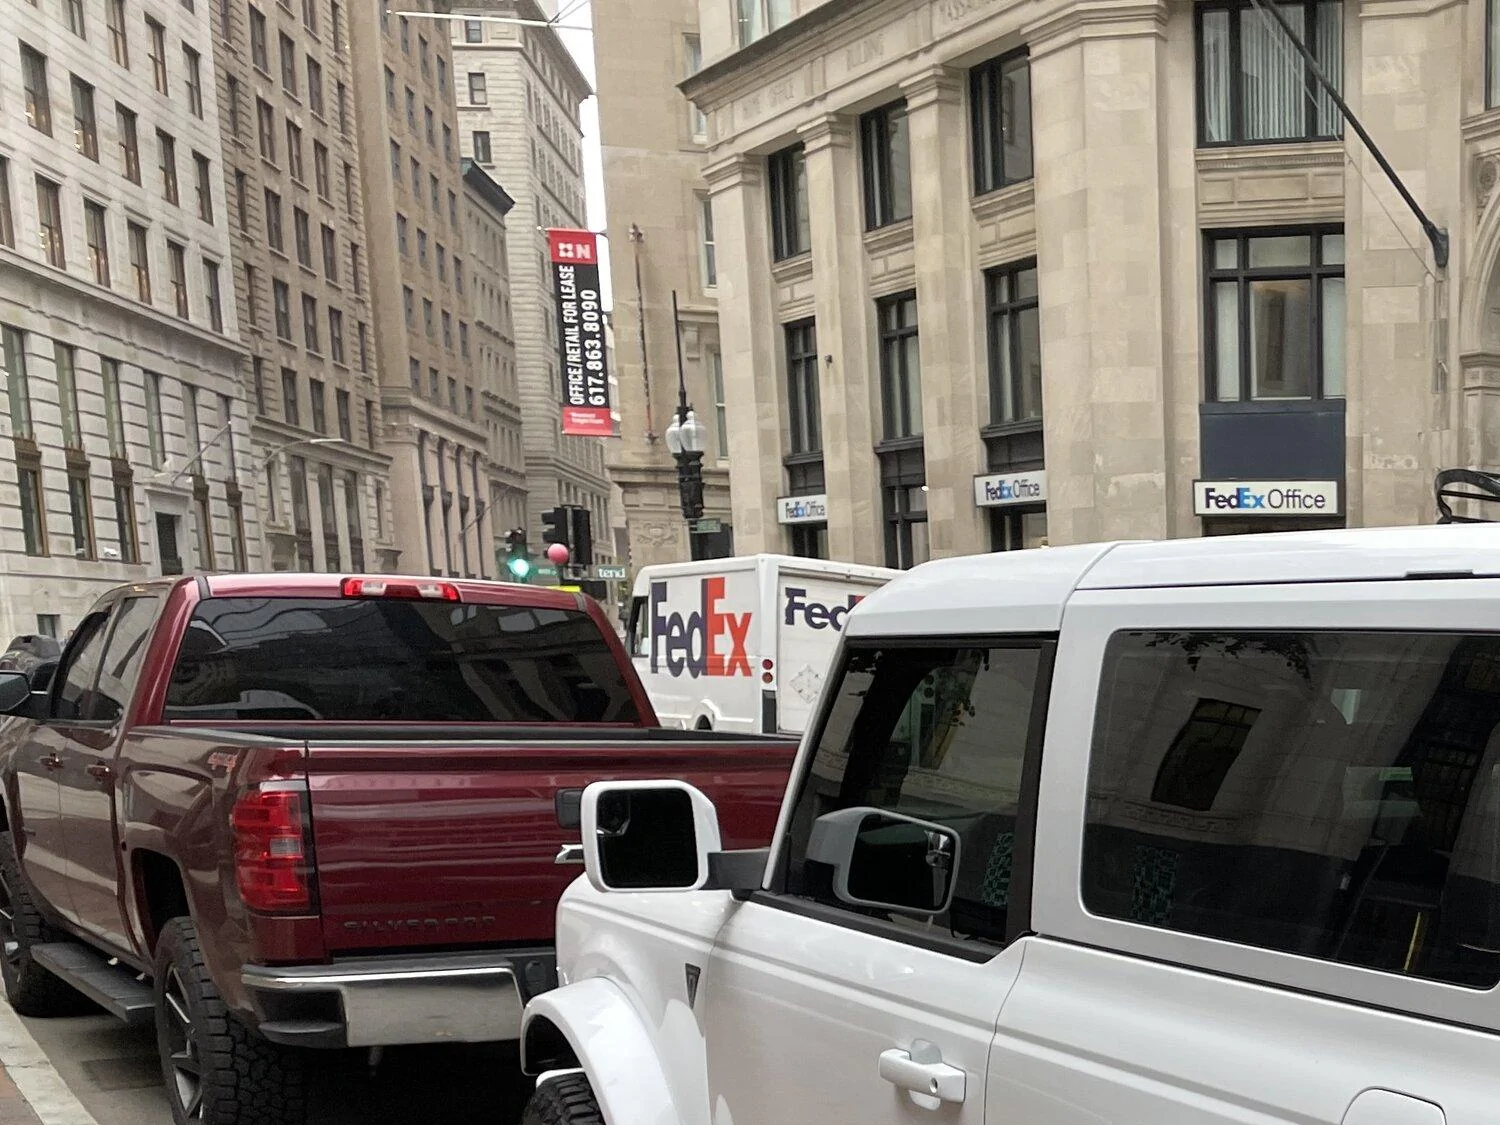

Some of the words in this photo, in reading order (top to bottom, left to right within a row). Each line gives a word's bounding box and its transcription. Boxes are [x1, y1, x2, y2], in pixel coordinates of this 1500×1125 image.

[558, 265, 577, 299] LEASE
[562, 301, 579, 323] FOR
[580, 289, 606, 406] 617.863.8090
[564, 325, 585, 405] OFFICE/RETAIL
[984, 480, 1014, 501] FedEx
[1013, 479, 1040, 498] Office
[1205, 487, 1266, 509] FedEx
[1267, 489, 1326, 509] Office
[651, 577, 752, 679] FedEx
